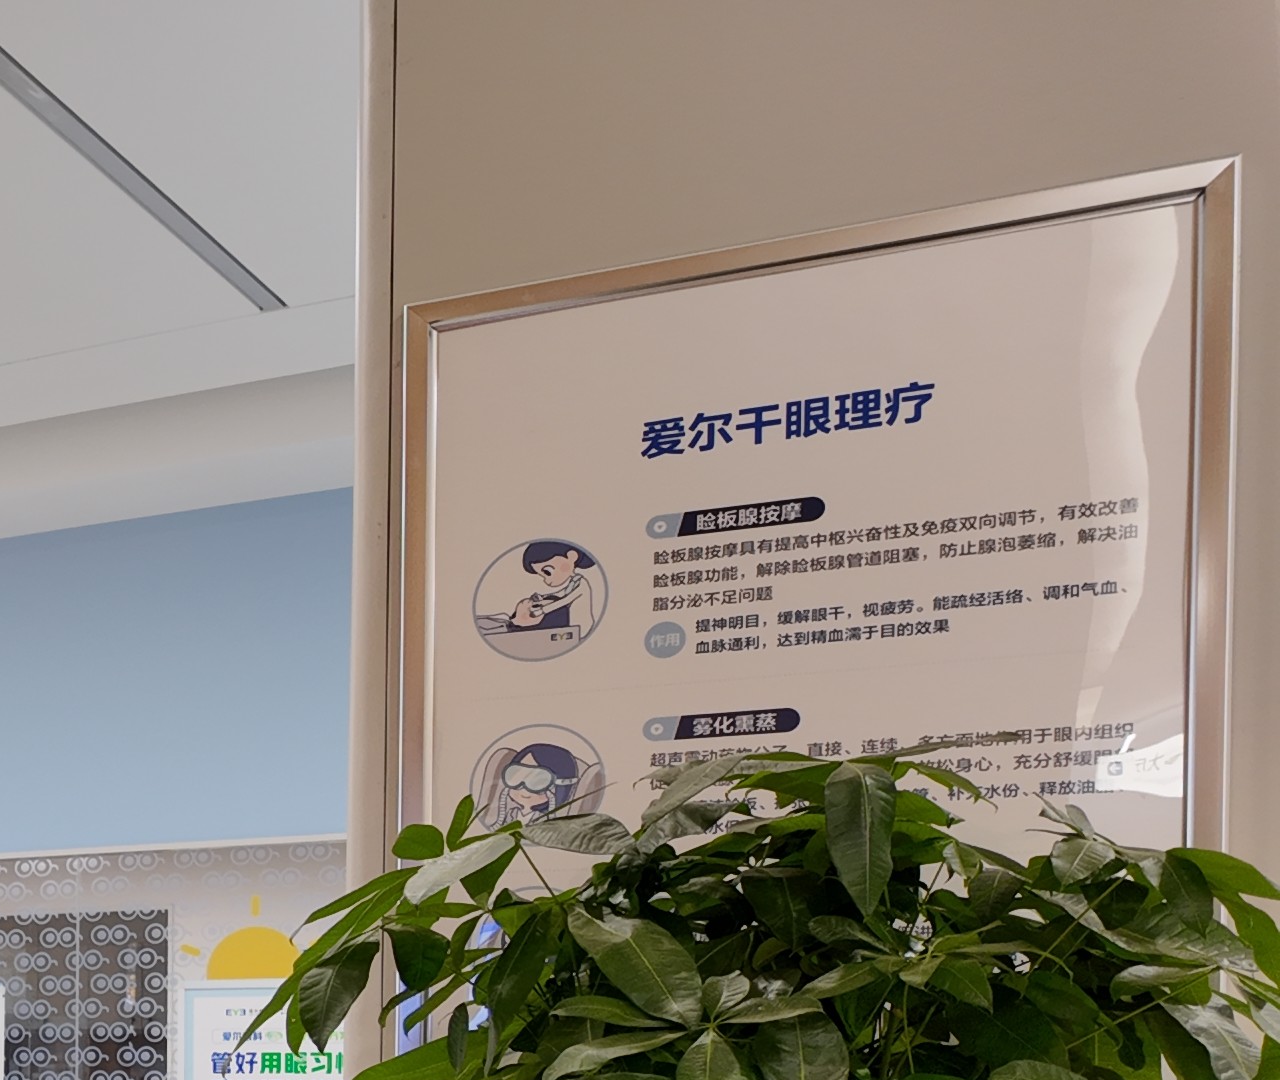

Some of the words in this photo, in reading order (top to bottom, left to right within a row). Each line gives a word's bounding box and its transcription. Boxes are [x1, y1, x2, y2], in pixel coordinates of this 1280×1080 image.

[640, 381, 936, 459] 爱尔干眼理疗
[695, 501, 803, 531] 睑板腺按摩
[652, 585, 774, 611] 脂分泌不足问题
[648, 631, 681, 649] 作用
[692, 712, 778, 736] 雾化熏蒸
